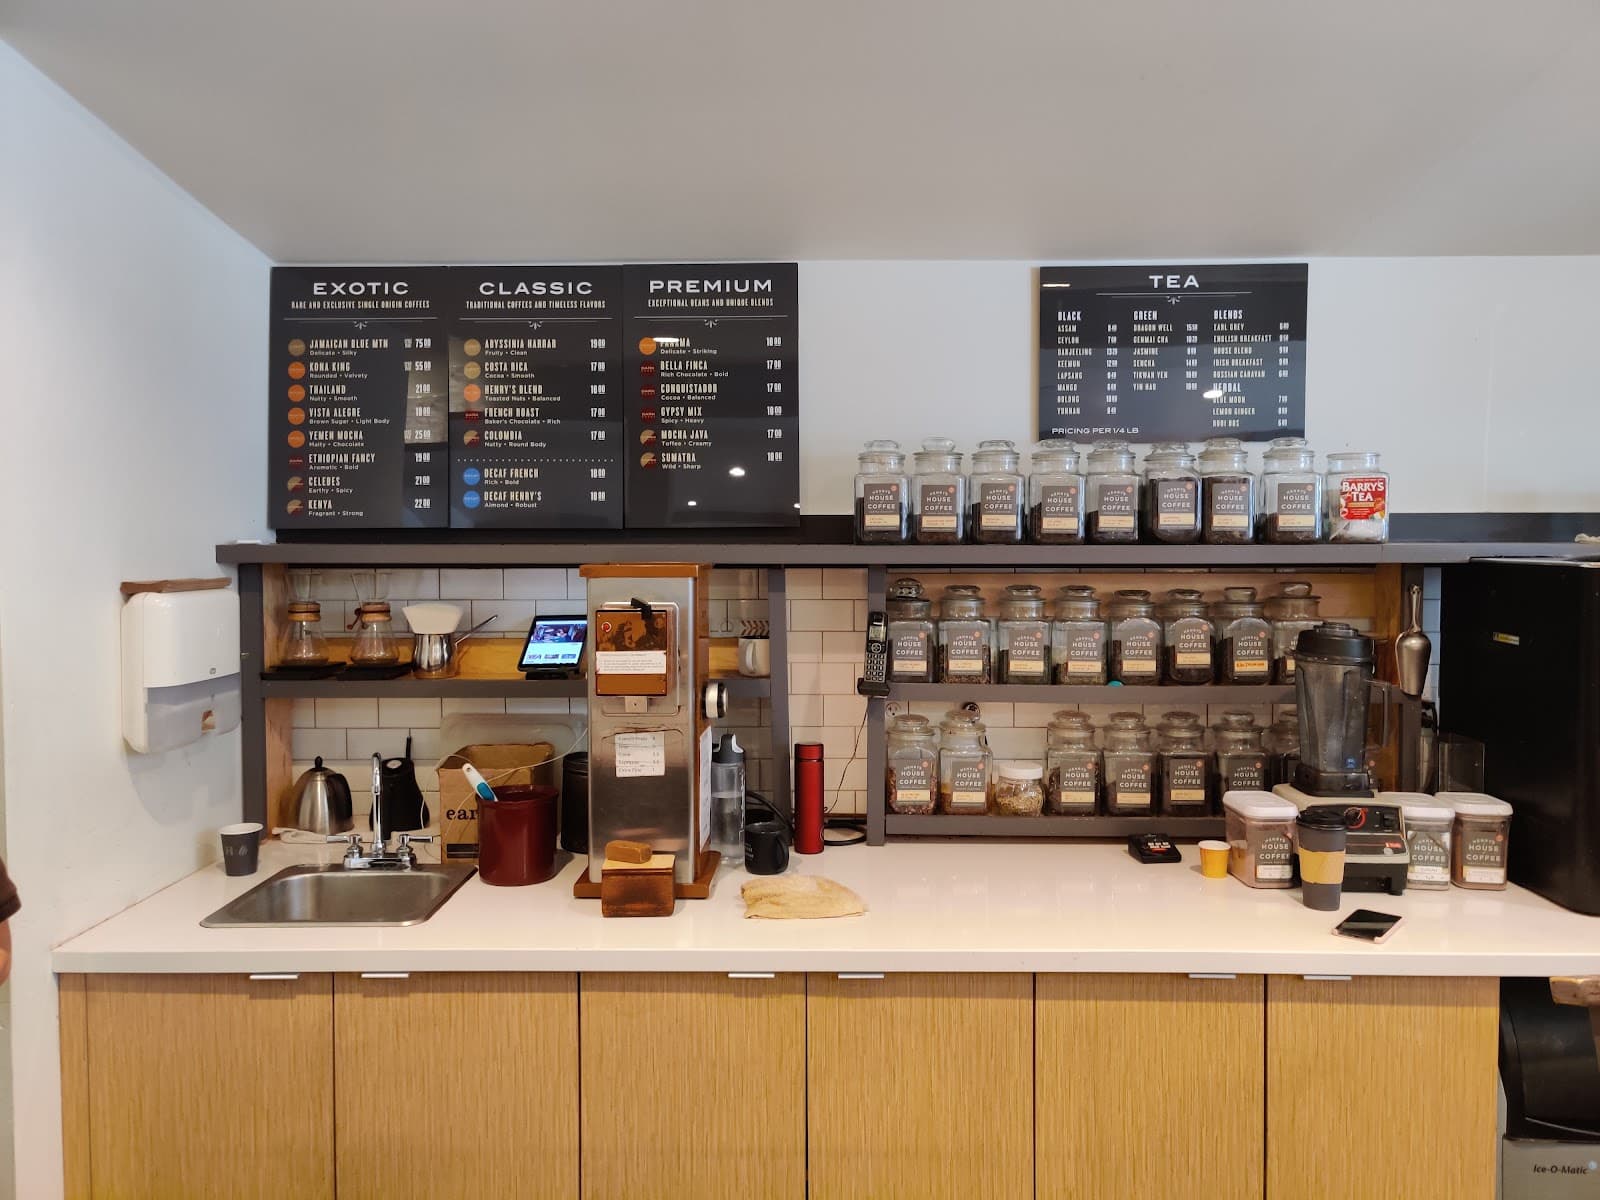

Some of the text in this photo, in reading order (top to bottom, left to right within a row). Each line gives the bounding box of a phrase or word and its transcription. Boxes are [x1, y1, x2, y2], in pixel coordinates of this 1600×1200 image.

[649, 279, 772, 293] PREMIUM
[1148, 274, 1200, 289] TEA
[313, 282, 409, 295] EXOTIC
[479, 282, 593, 295] CLASSIC
[466, 301, 504, 309] TRADITIONAL
[507, 301, 532, 309] COFFEES
[580, 300, 606, 308] FLAVORS
[648, 299, 688, 307] EXCEPTIONAL
[691, 299, 709, 307] BEANS
[712, 299, 723, 307] AND
[751, 298, 773, 306] BLENDS
[1058, 312, 1081, 321] BLACK
[1133, 311, 1157, 320] GREEN
[1214, 310, 1242, 319] BLENDS
[310, 339, 388, 349] JAMAICAN BLUE MTN
[310, 362, 350, 371] KONA KING
[485, 362, 528, 372] COSTA RICA
[661, 361, 708, 370] BELLA FINCA
[309, 385, 346, 394] THAILAND
[485, 385, 543, 394] HENRY'S BLEND
[661, 384, 717, 394] CONQUISTADOR
[309, 408, 360, 417] VISTA ALEGRE
[485, 408, 539, 417] FRENCH ROAST
[661, 407, 702, 416] GYPSY MIX
[309, 431, 363, 440] YEMEN MOCHA
[485, 431, 522, 440] COLOMBIA
[661, 430, 708, 439] MOCHA JAVA
[309, 454, 375, 463] ETHIOPIAN FANCY
[661, 453, 696, 462] SUMATRA
[484, 468, 539, 478] DECAF FRENCH
[309, 477, 340, 486] CELEBES
[1342, 481, 1384, 492] BARRY'S
[484, 492, 542, 501] DECAF HENRY'S
[1351, 492, 1373, 501] TEA
[308, 500, 332, 509] KENYA
[1533, 1164, 1588, 1174] Ice-O-Matic
